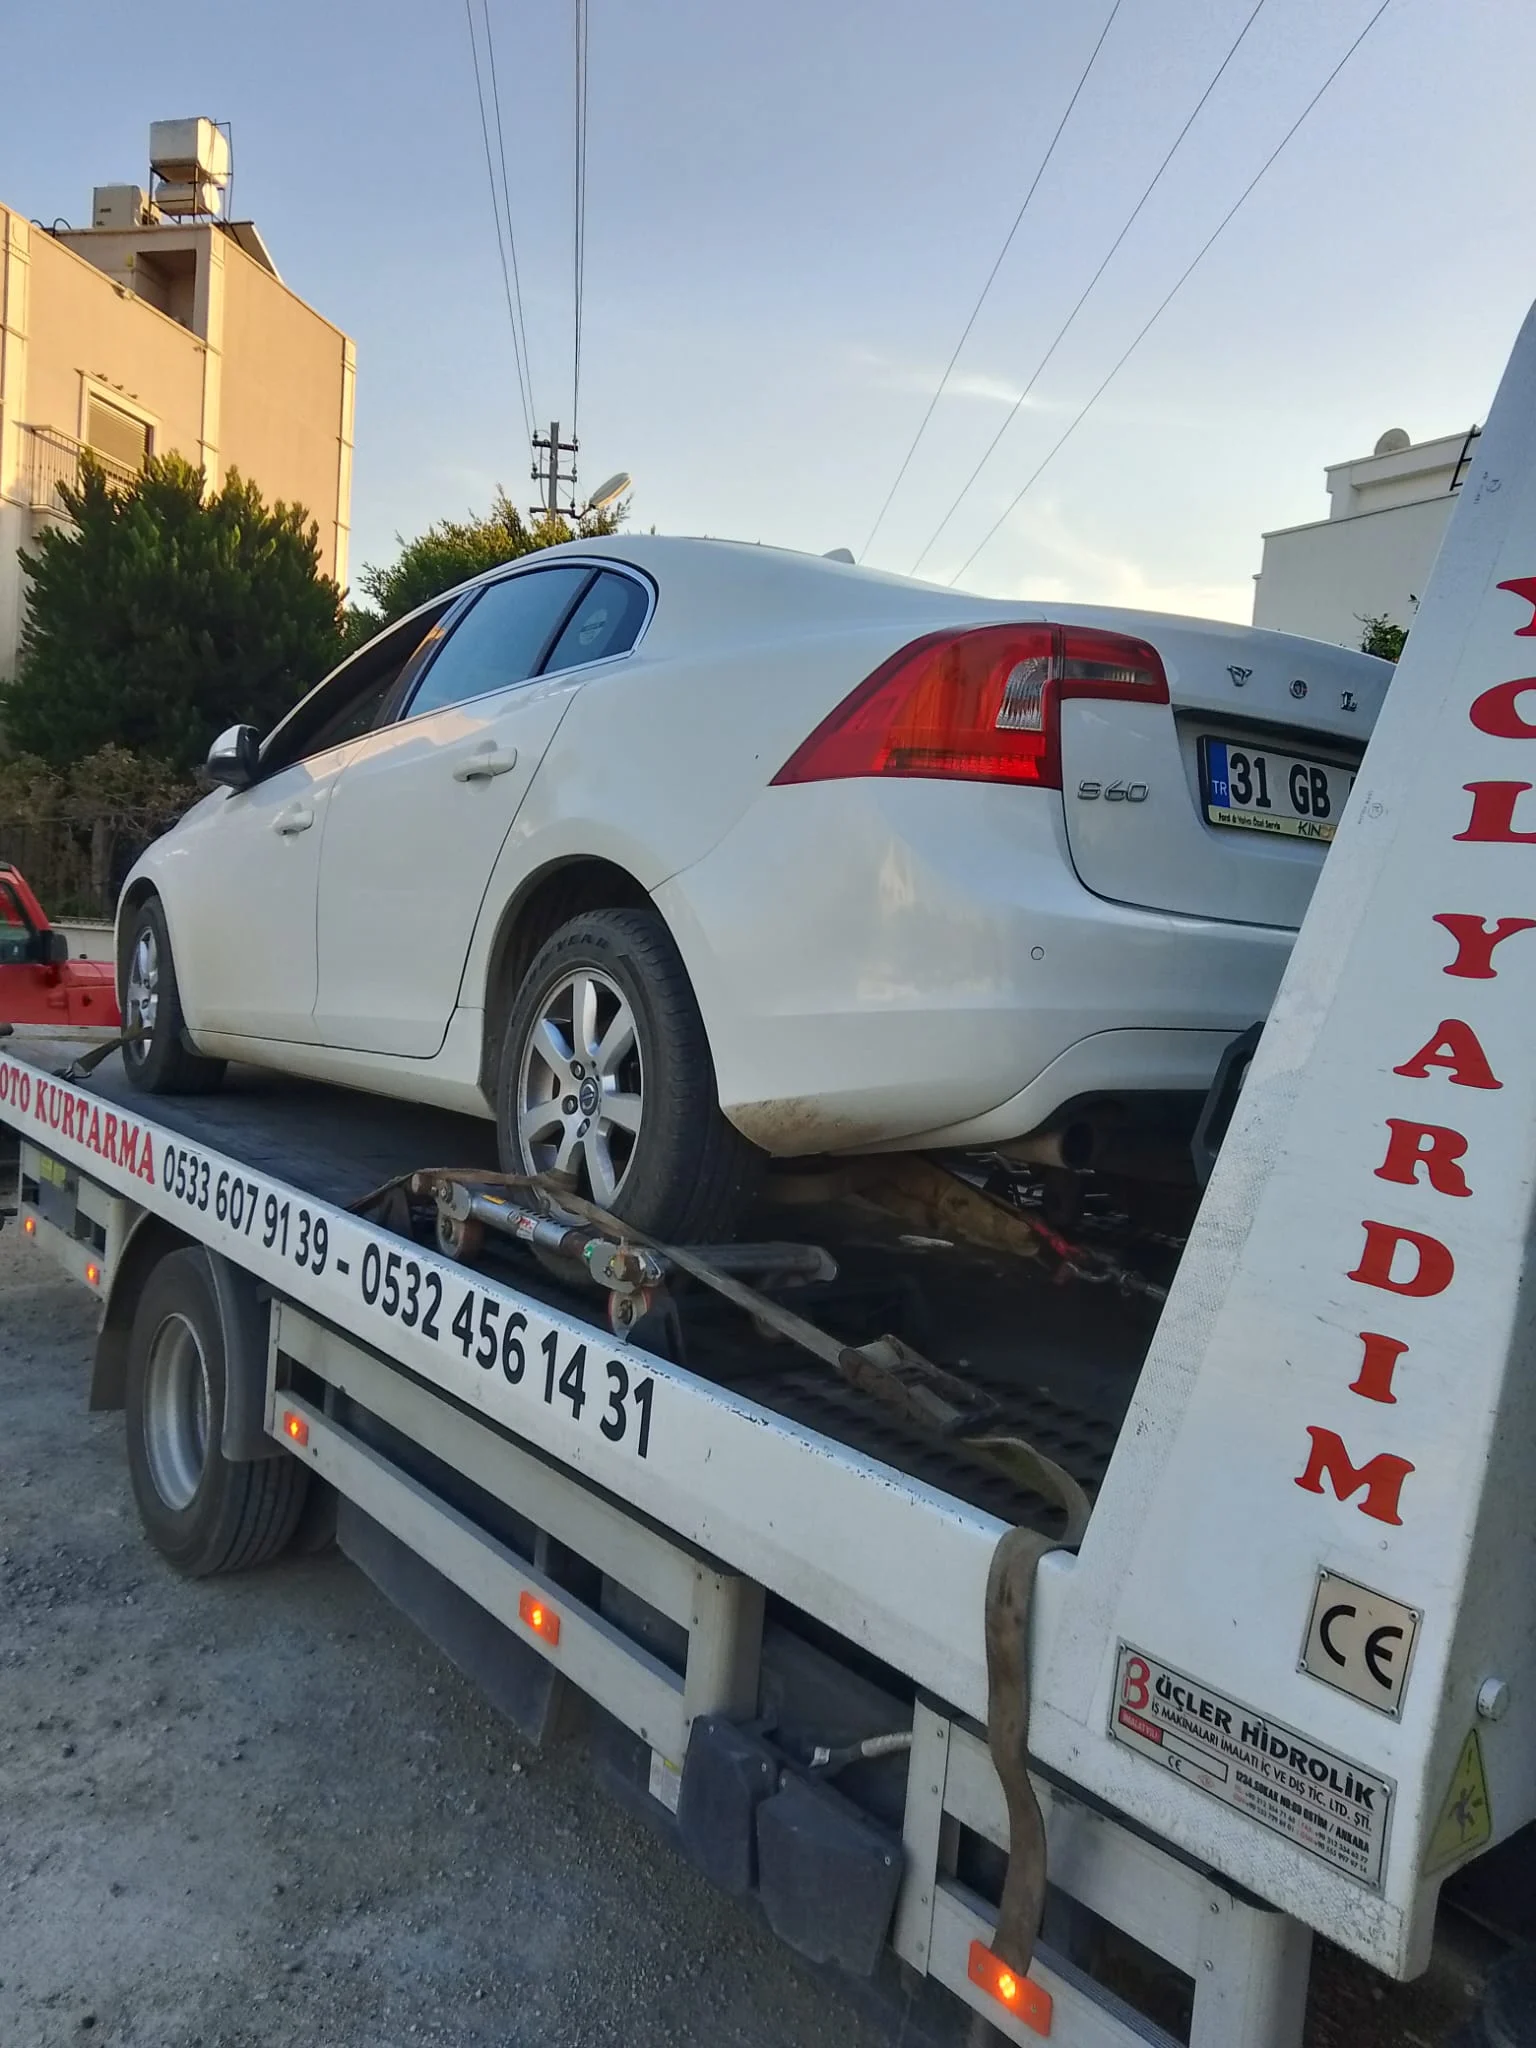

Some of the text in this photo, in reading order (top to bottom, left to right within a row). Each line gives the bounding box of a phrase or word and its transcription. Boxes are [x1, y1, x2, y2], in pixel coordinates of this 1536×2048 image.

[1077, 779, 1149, 802] S60
[1213, 780, 1228, 797] TR
[1230, 753, 1272, 809] 31
[1288, 764, 1331, 819] GB
[0, 1062, 30, 1112] OTO
[35, 1078, 155, 1184] KURTARMA
[163, 1145, 210, 1211] 0533
[216, 1171, 258, 1235] 607
[263, 1194, 290, 1255] 91
[295, 1209, 328, 1275] 39
[362, 1242, 442, 1341] 0532
[452, 1290, 528, 1385] 456
[541, 1330, 587, 1420] 14
[599, 1360, 654, 1459] 31
[1320, 1603, 1403, 1690] CE
[1156, 1673, 1376, 1810] ÜÇLER HİDROLİK
[1221, 1735, 1258, 1768] İMALATI
[1274, 1767, 1286, 1784] VE
[1289, 1776, 1305, 1795] DIŞ
[1329, 1798, 1350, 1820] LTD.
[1335, 1825, 1370, 1854] ANKARA
